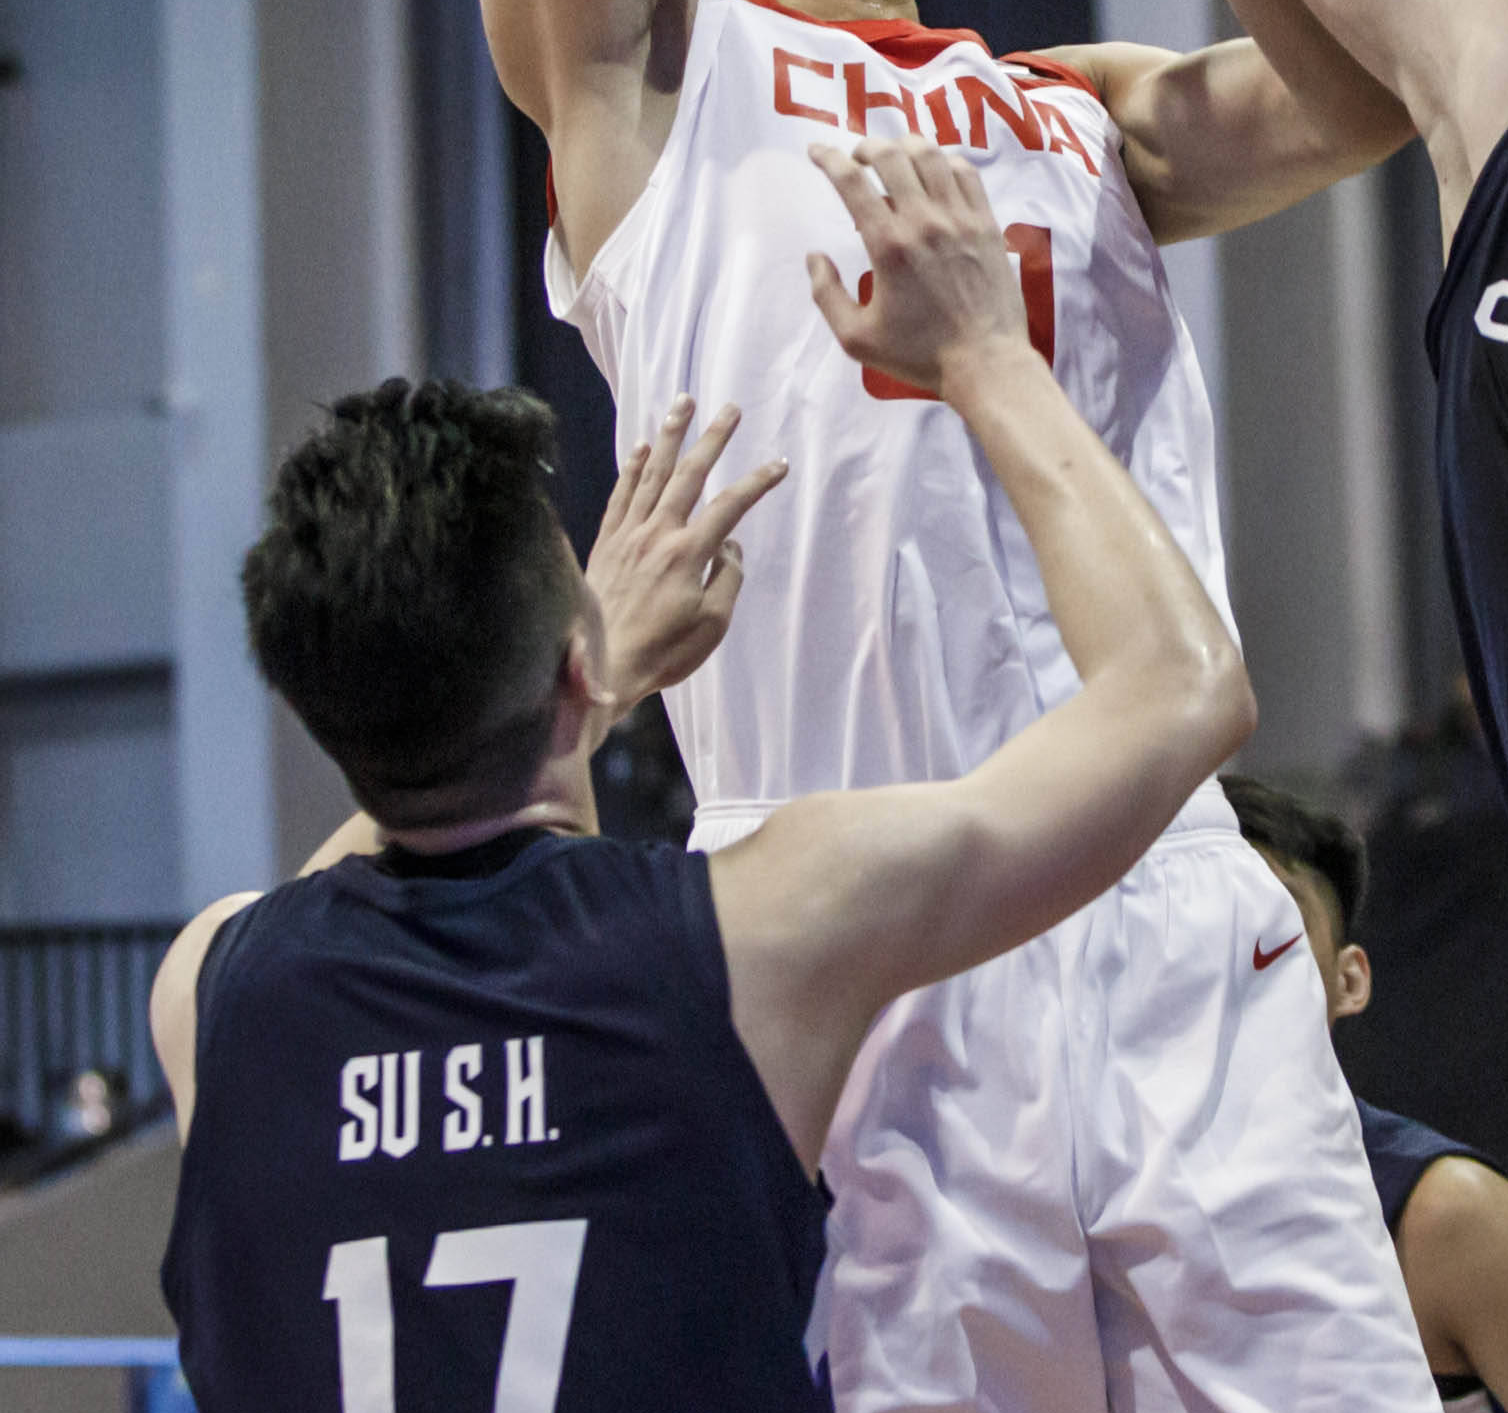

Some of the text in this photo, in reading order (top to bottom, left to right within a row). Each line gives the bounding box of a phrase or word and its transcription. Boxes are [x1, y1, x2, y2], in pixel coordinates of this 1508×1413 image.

[772, 46, 1102, 179] CHINA
[339, 1035, 560, 1161] SU S.H.
